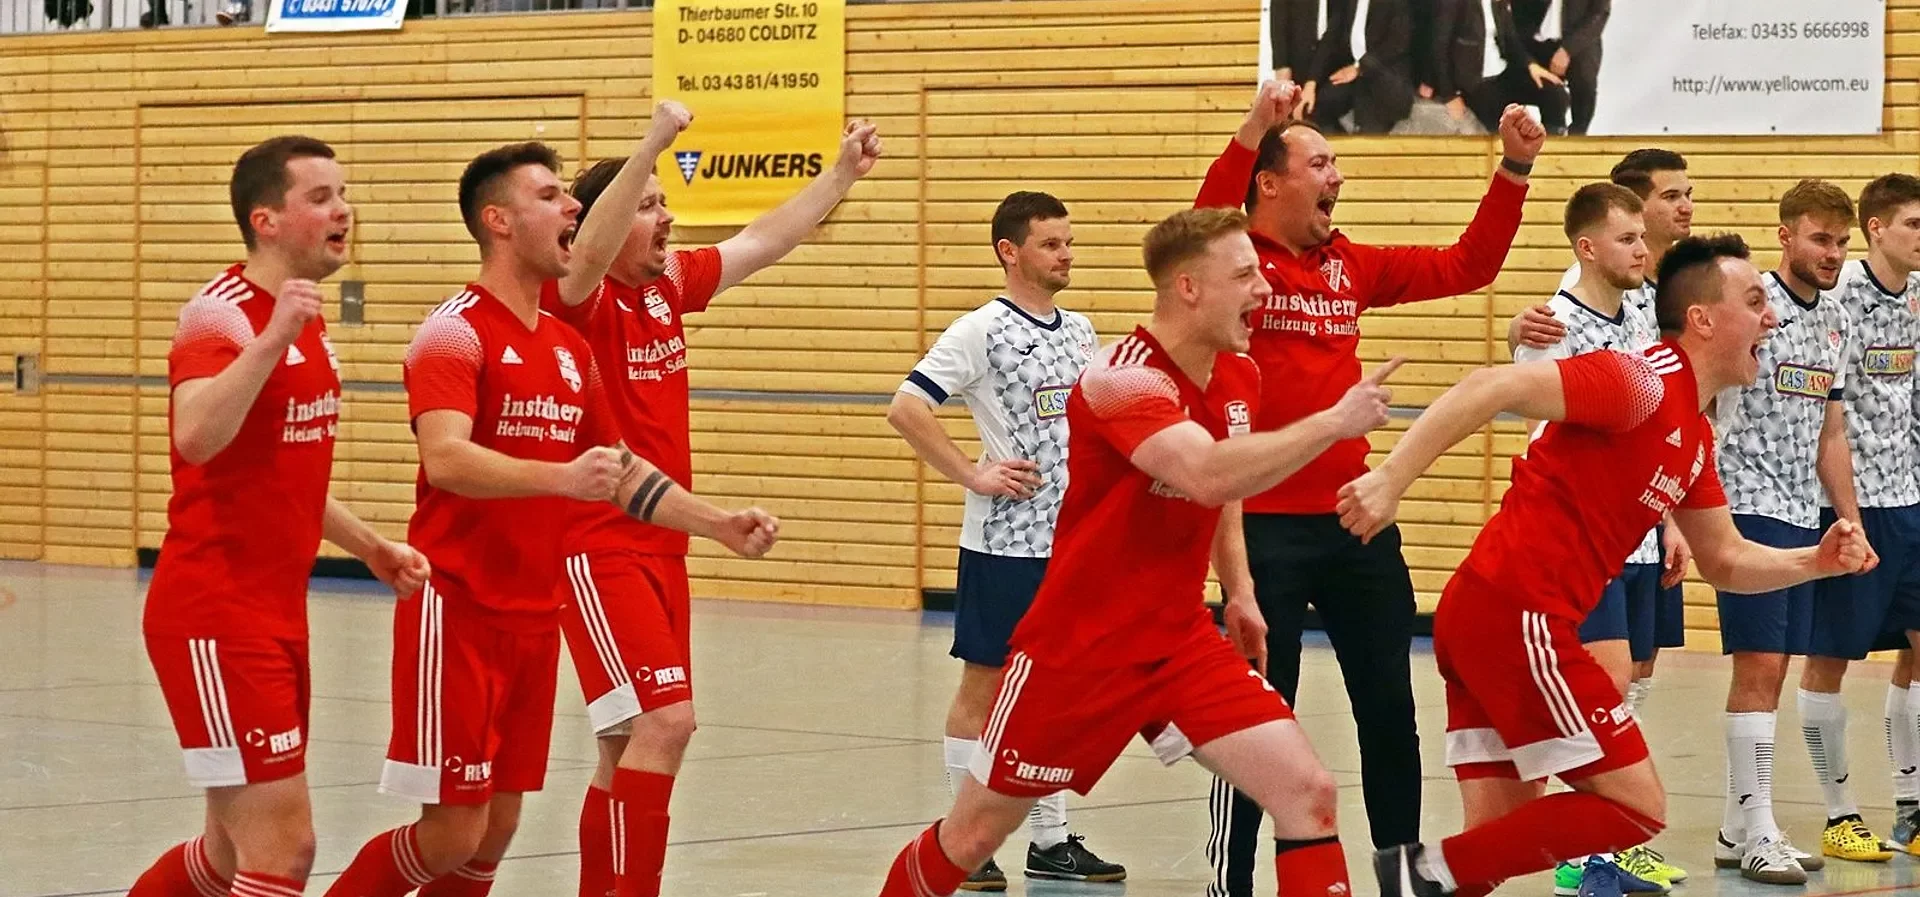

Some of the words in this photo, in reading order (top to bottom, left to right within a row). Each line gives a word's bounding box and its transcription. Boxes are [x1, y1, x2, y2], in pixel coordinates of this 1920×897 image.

[679, 6, 770, 22] Thierbaumer
[773, 3, 799, 19] Str.
[802, 3, 817, 18] 10
[678, 28, 693, 44] D-
[697, 26, 745, 43] 04680
[750, 24, 817, 42] COLDITZ
[1692, 23, 1748, 40] Telefax:
[1752, 23, 1797, 39] 03435
[1803, 22, 1869, 39] 6666998
[677, 75, 699, 91] Tel.
[1672, 75, 1869, 96] http://www.yellowcom.eu
[702, 153, 823, 179] JUNKERS
[1262, 314, 1317, 336] Heizung
[1016, 761, 1074, 783] REHAU
